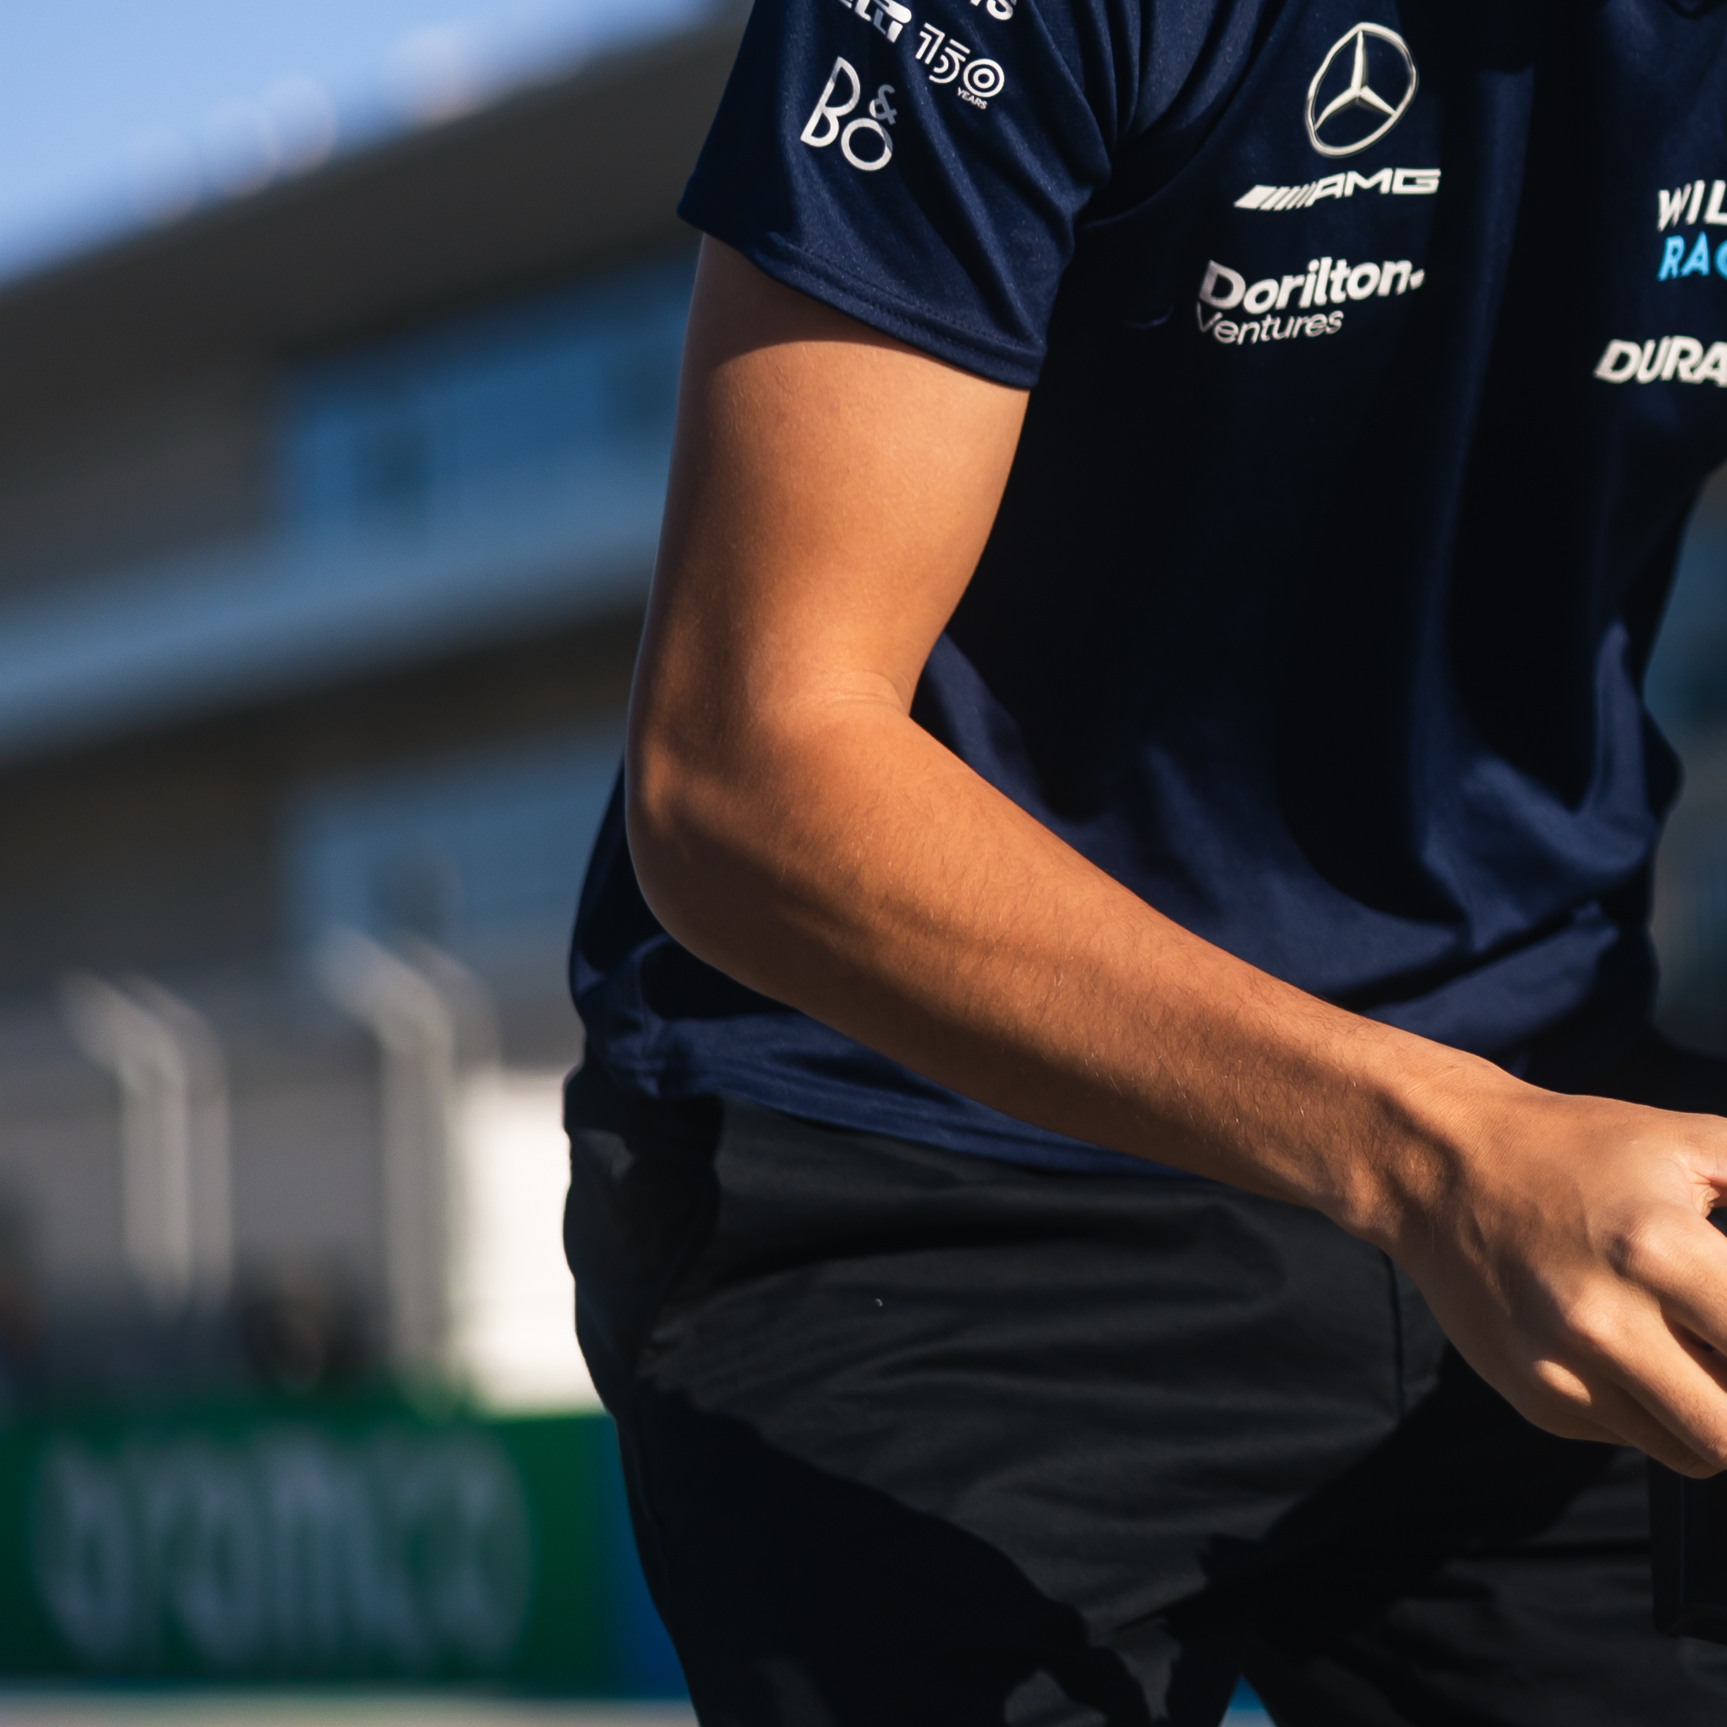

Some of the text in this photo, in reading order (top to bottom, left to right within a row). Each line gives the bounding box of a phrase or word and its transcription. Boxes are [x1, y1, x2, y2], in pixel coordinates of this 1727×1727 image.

[916, 22, 1005, 99] 150
[956, 87, 988, 111] YEARS
[1304, 167, 1441, 208] AMG
[1197, 302, 1344, 346] Ventures
